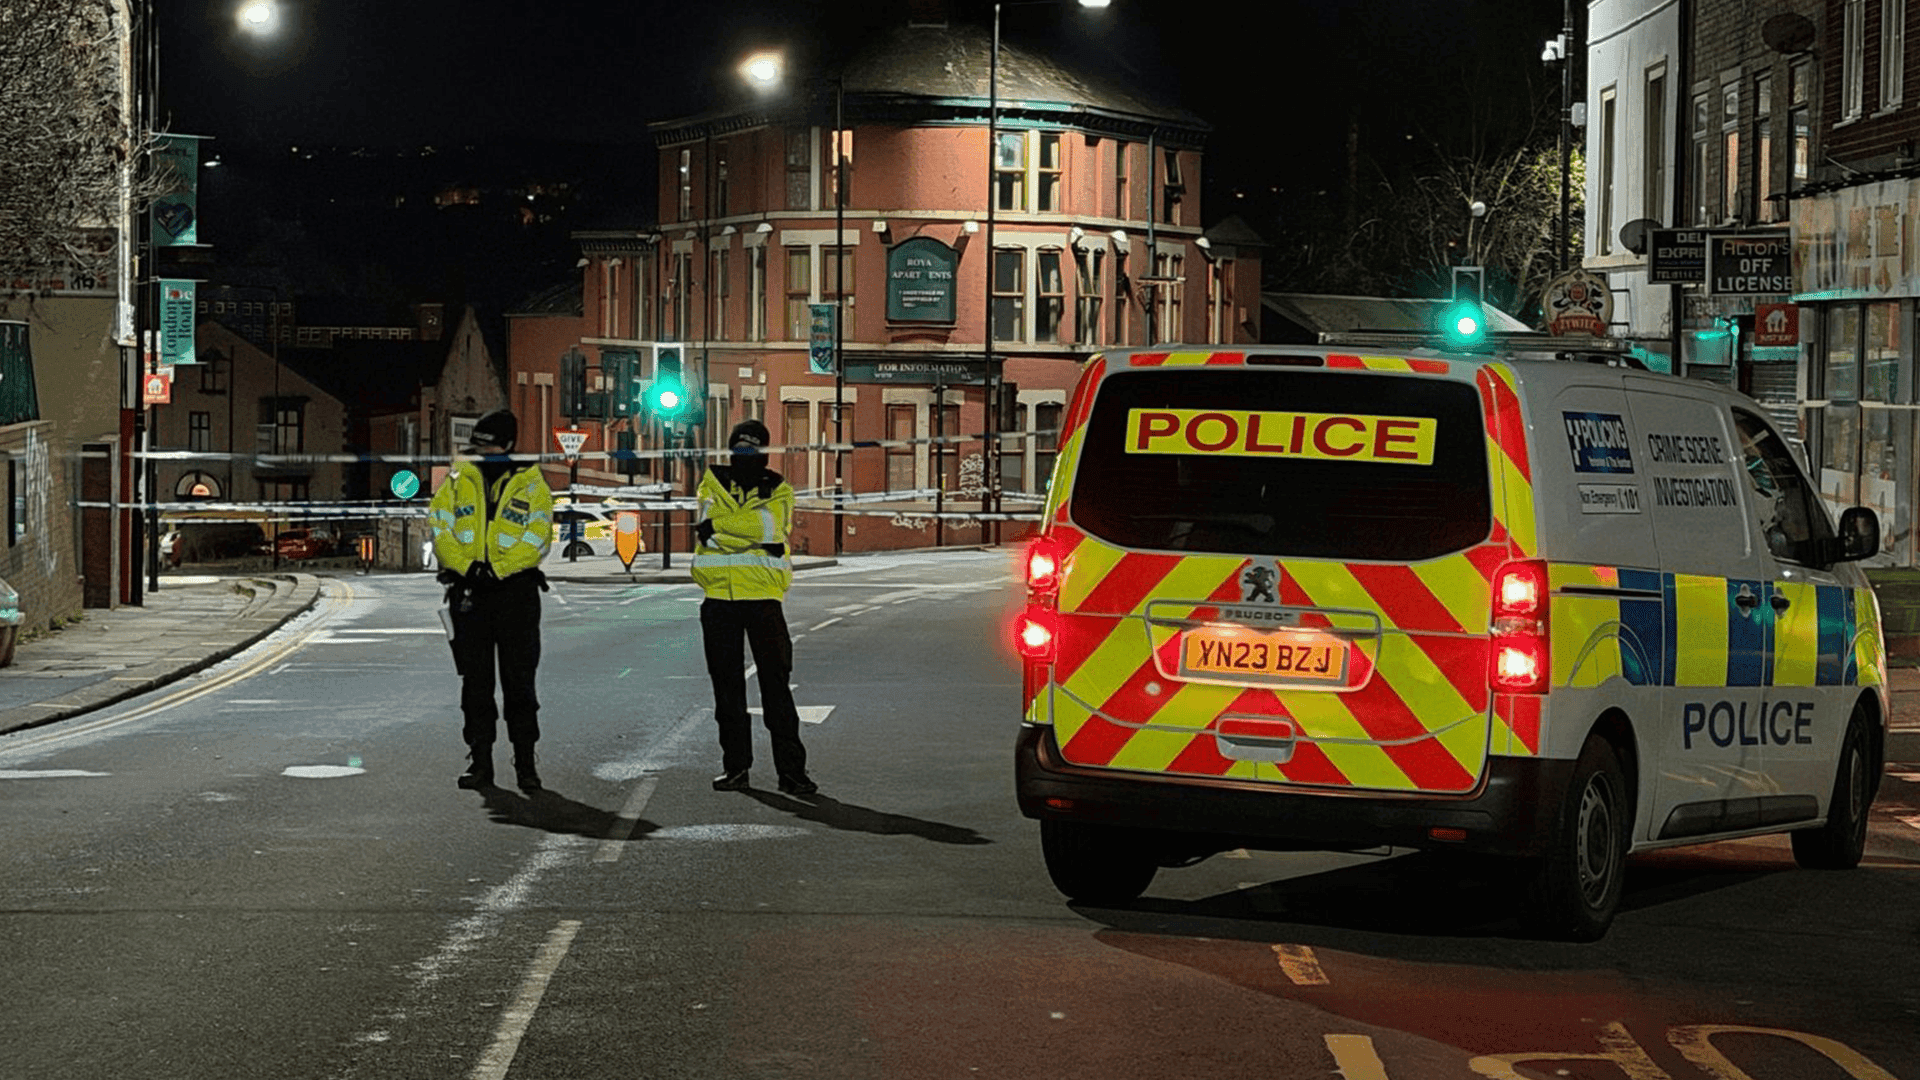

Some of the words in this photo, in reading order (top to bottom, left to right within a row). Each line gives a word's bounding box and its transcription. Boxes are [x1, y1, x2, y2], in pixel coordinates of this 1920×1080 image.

[1740, 258, 1773, 273] OFF
[1717, 276, 1793, 292] LICENSE
[878, 363, 898, 372] FOR
[900, 363, 969, 374] INFORMATION
[560, 435, 582, 443] GIVE
[1137, 412, 1420, 460] POLICE
[1648, 433, 1687, 463] CRIME
[1684, 435, 1724, 464] SCENE
[1653, 477, 1736, 506] INVESTIGATION
[1201, 640, 1268, 670] YN23
[1275, 645, 1331, 673] BZJ
[1683, 700, 1815, 750] POLICE
